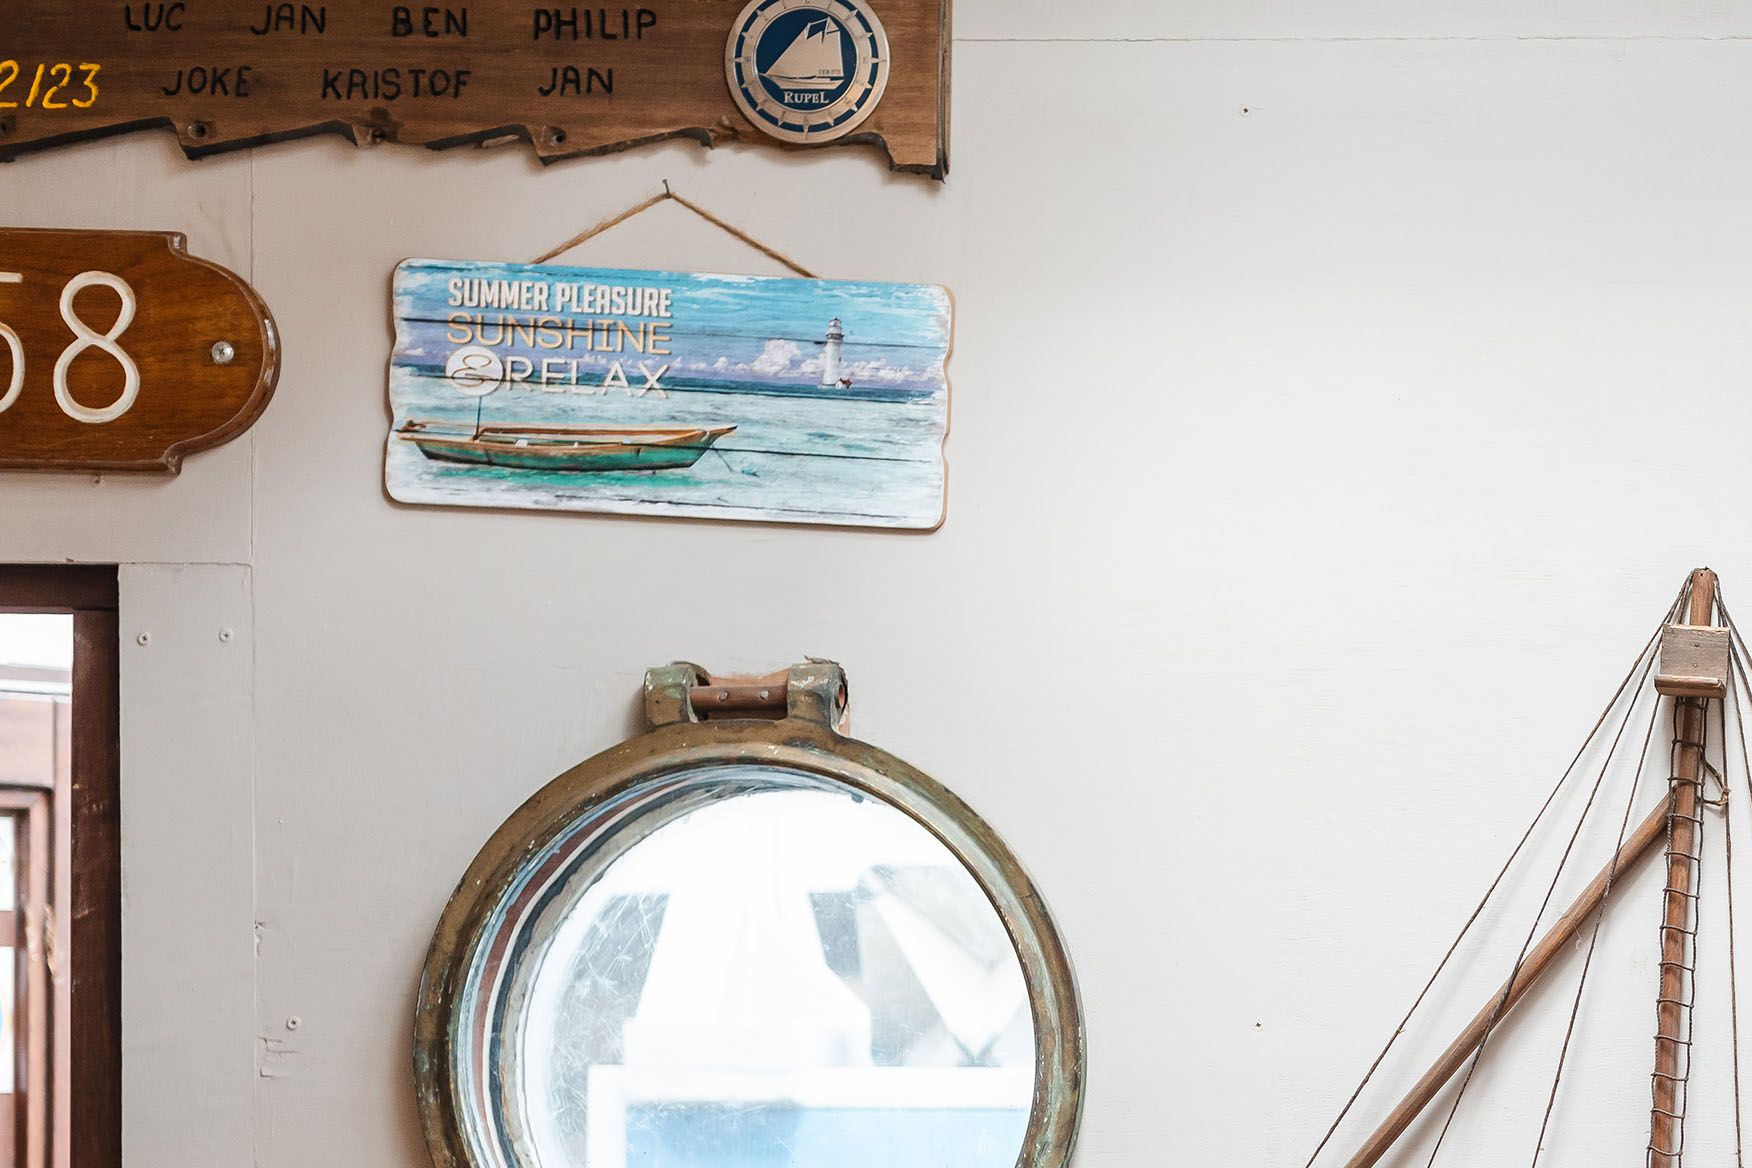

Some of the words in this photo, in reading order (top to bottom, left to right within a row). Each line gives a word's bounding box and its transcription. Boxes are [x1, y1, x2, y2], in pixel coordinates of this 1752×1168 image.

[124, 2, 185, 31] LUC
[250, 3, 326, 35] JAN
[391, 7, 467, 37] BEN
[533, 8, 657, 40] PHILIP
[162, 66, 252, 96] JOKE
[321, 67, 471, 100] KRISTOF
[538, 66, 614, 97] JAN
[448, 277, 549, 312] SUMMER
[554, 282, 673, 318] PLEASURE
[447, 311, 673, 355] SUNSHINE
[504, 355, 671, 399] RELAX
